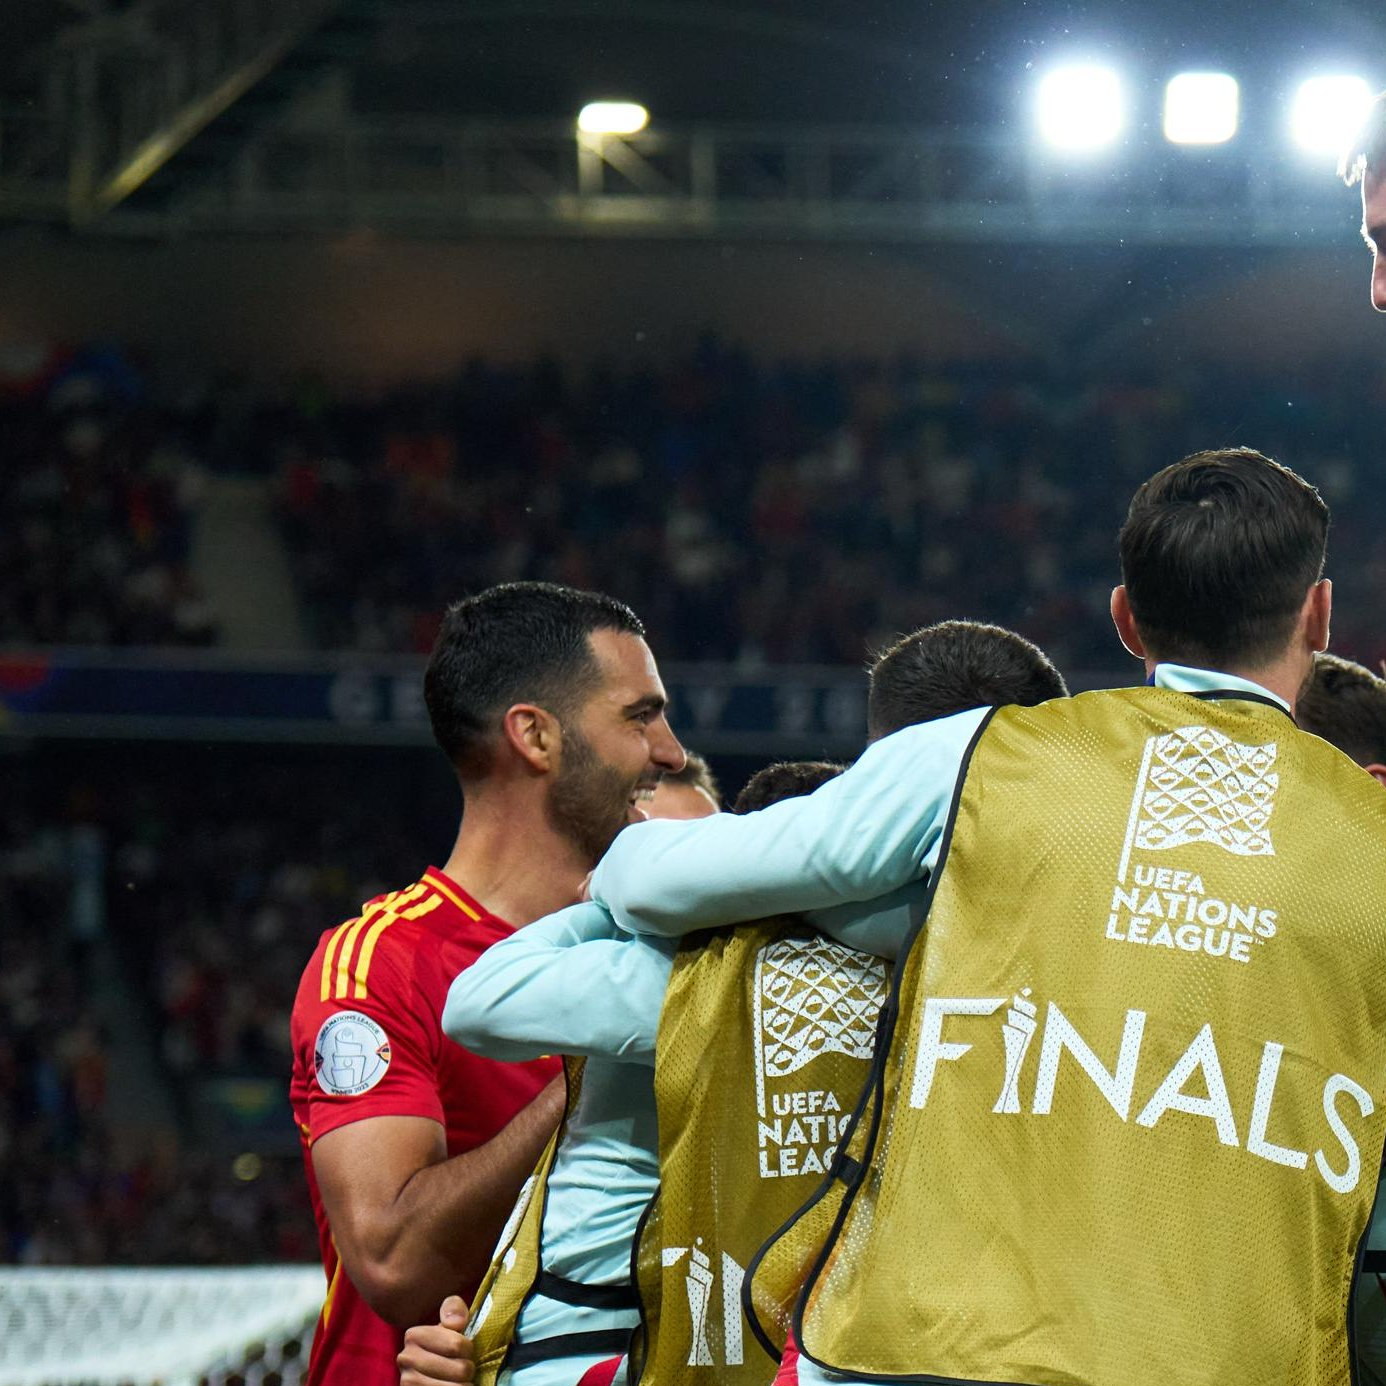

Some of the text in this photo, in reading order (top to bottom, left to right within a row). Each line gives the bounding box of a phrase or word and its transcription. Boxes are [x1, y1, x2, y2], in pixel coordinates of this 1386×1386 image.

[1134, 864, 1205, 896] UEFA
[1111, 886, 1278, 938] NATIONS
[1105, 913, 1254, 964] LEAGUE
[772, 1091, 841, 1116] UEFA
[909, 987, 1375, 1195] FINALS
